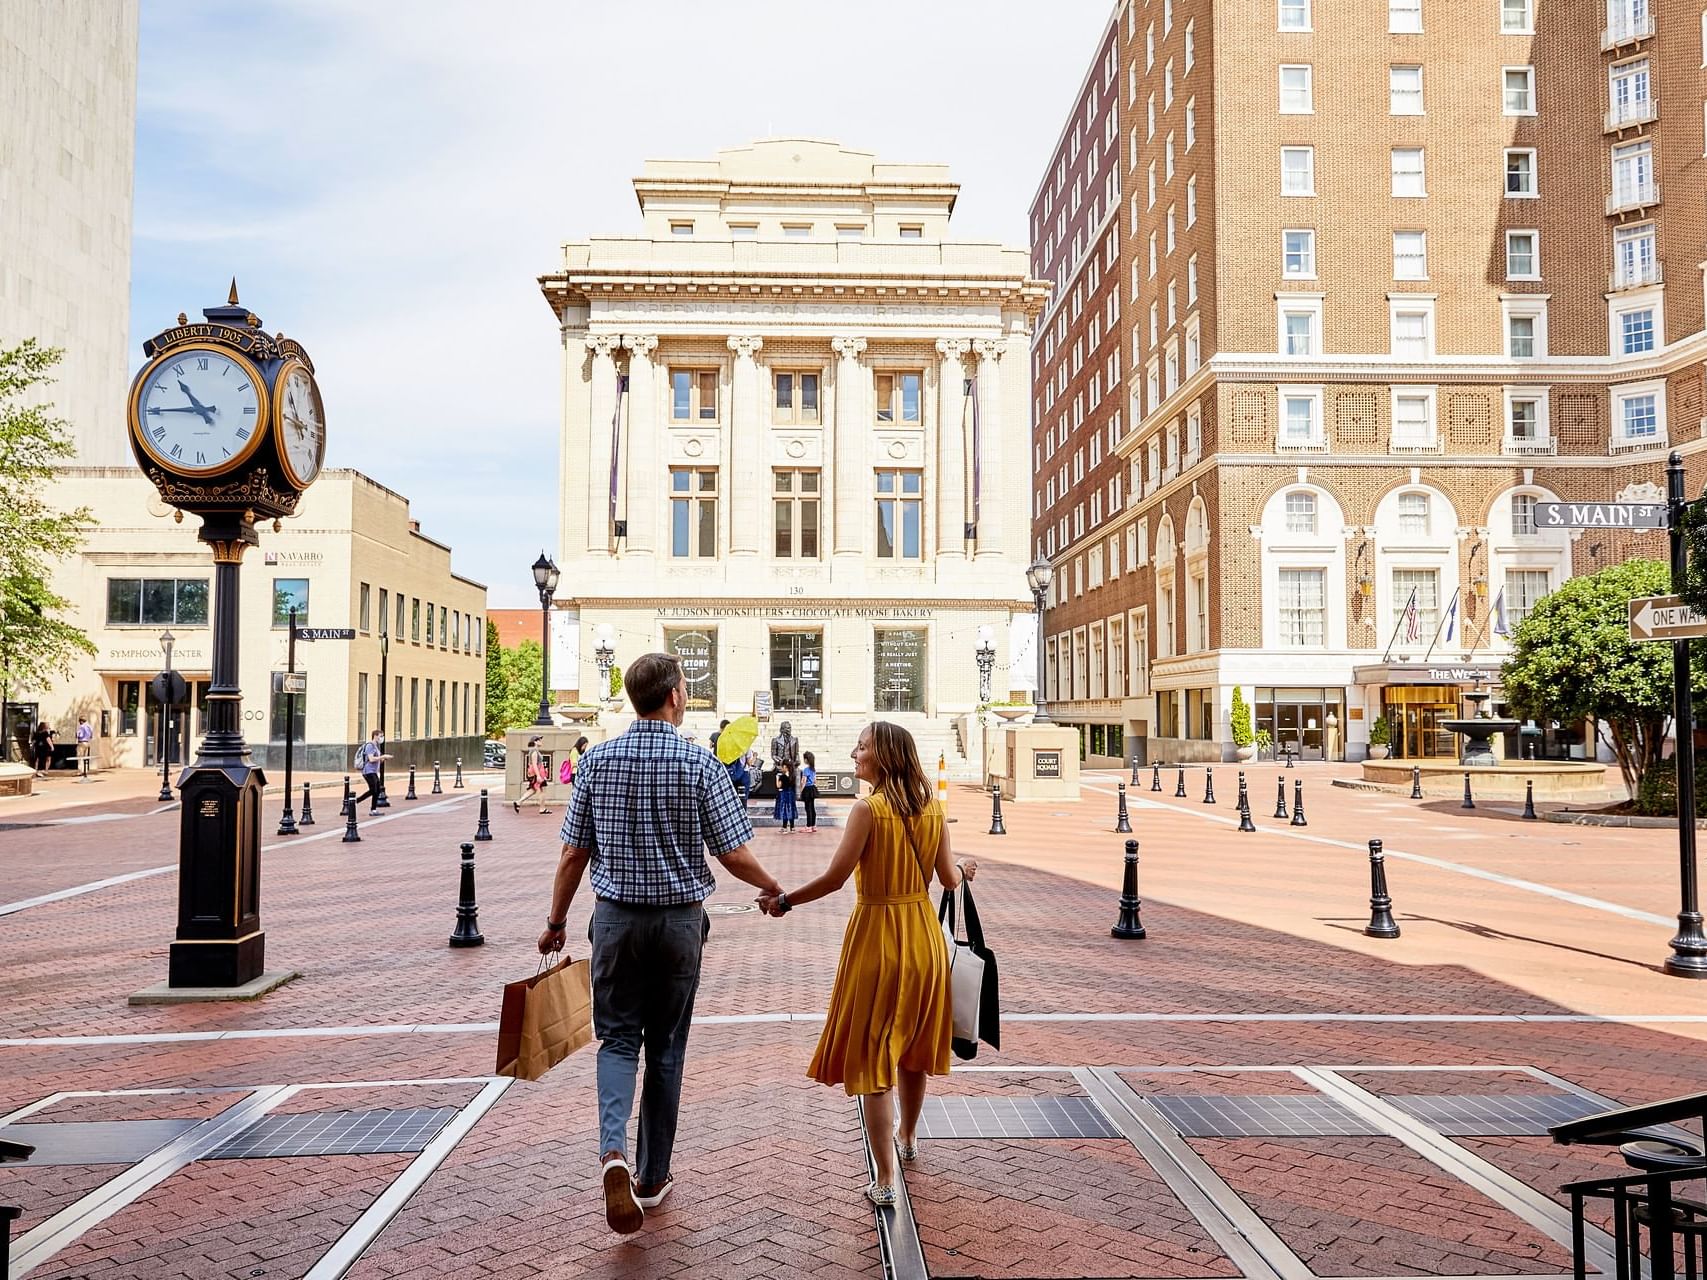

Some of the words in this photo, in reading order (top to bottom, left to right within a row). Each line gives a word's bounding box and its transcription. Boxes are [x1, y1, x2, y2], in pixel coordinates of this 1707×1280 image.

[164, 325, 213, 344] LIBERTY
[218, 328, 243, 344] 1905
[1548, 505, 1564, 525] S.
[1569, 505, 1634, 526] MAIN
[1639, 505, 1653, 517] ST
[280, 552, 324, 561] NAVARRO
[789, 586, 804, 595] 130
[671, 608, 710, 617] JUDSON
[713, 608, 784, 617] BOOKSELLERS
[792, 608, 850, 617] CHOCOLATE
[855, 609, 889, 618] MOOSE
[893, 609, 933, 618] BAKERY
[1653, 609, 1675, 626] ONE
[302, 629, 310, 639] S.
[312, 629, 341, 639] MAIN
[110, 649, 163, 658] SYMPHONY
[172, 650, 202, 658] ENTER
[677, 648, 695, 656] TELL
[697, 648, 709, 656] ME
[1428, 669, 1450, 680] THE
